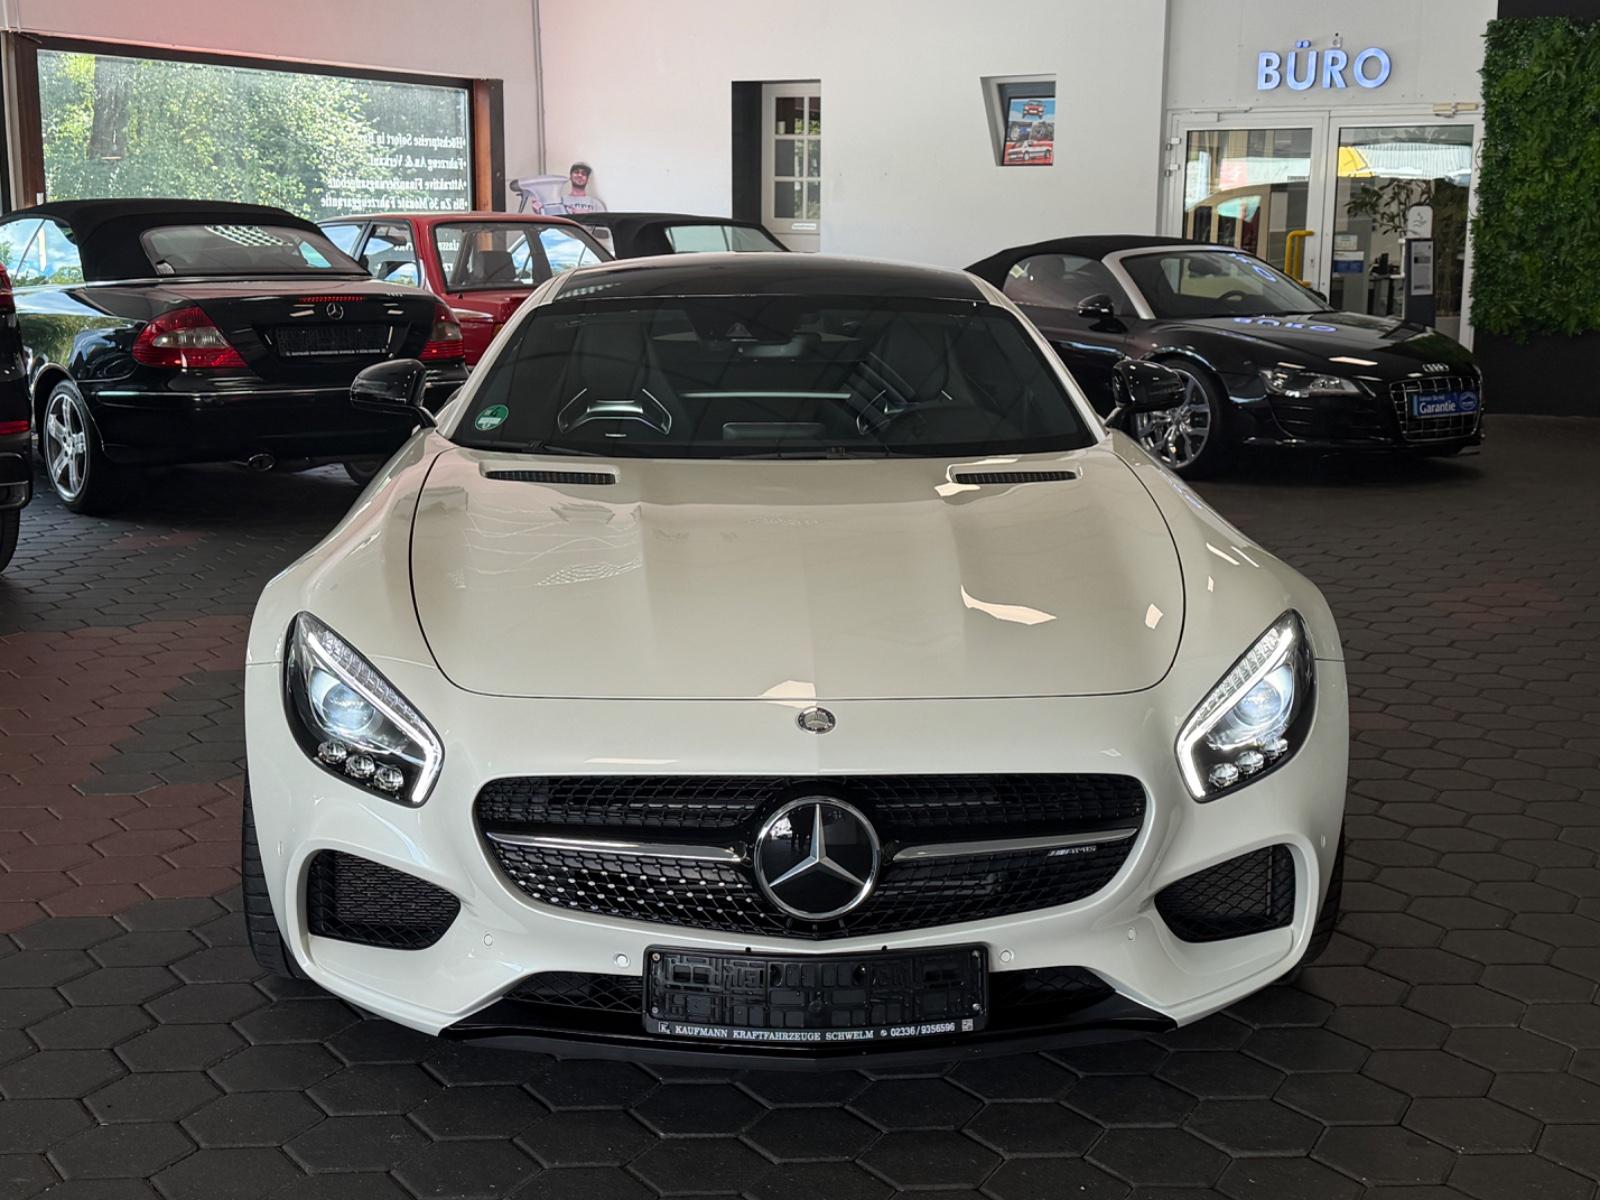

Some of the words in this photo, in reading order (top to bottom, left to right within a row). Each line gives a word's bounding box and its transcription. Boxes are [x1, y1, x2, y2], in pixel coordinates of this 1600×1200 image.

[1257, 39, 1392, 91] BÜRO
[1420, 400, 1457, 414] Garantie
[675, 1024, 728, 1038] KAUFMANN
[733, 1029, 821, 1041] KRAFTFAHRZEUGE
[825, 1029, 874, 1041] SCHWELM
